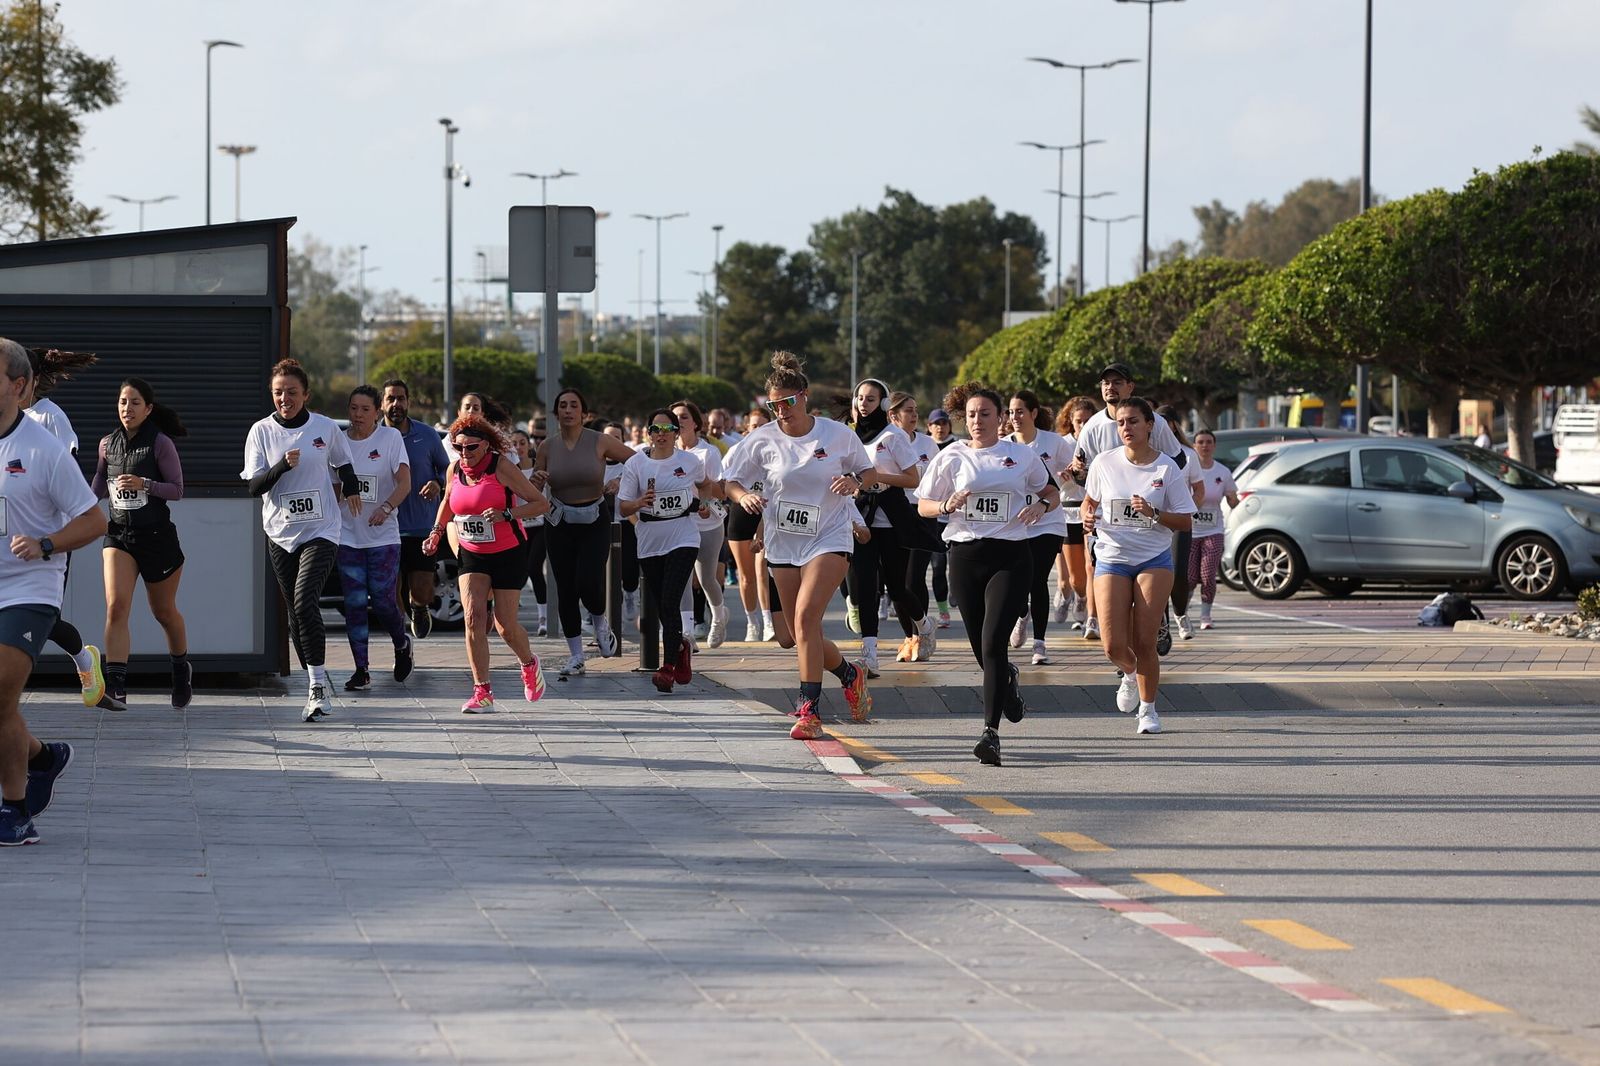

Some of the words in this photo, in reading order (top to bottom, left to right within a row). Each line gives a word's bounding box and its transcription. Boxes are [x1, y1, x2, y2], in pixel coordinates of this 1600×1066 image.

[359, 481, 369, 493] 06
[289, 498, 313, 514] 350
[660, 496, 681, 509] 382
[976, 498, 998, 513] 415
[786, 509, 809, 525] 416
[1123, 505, 1139, 518] 42
[1199, 512, 1213, 522] 333
[463, 521, 484, 533] 456
